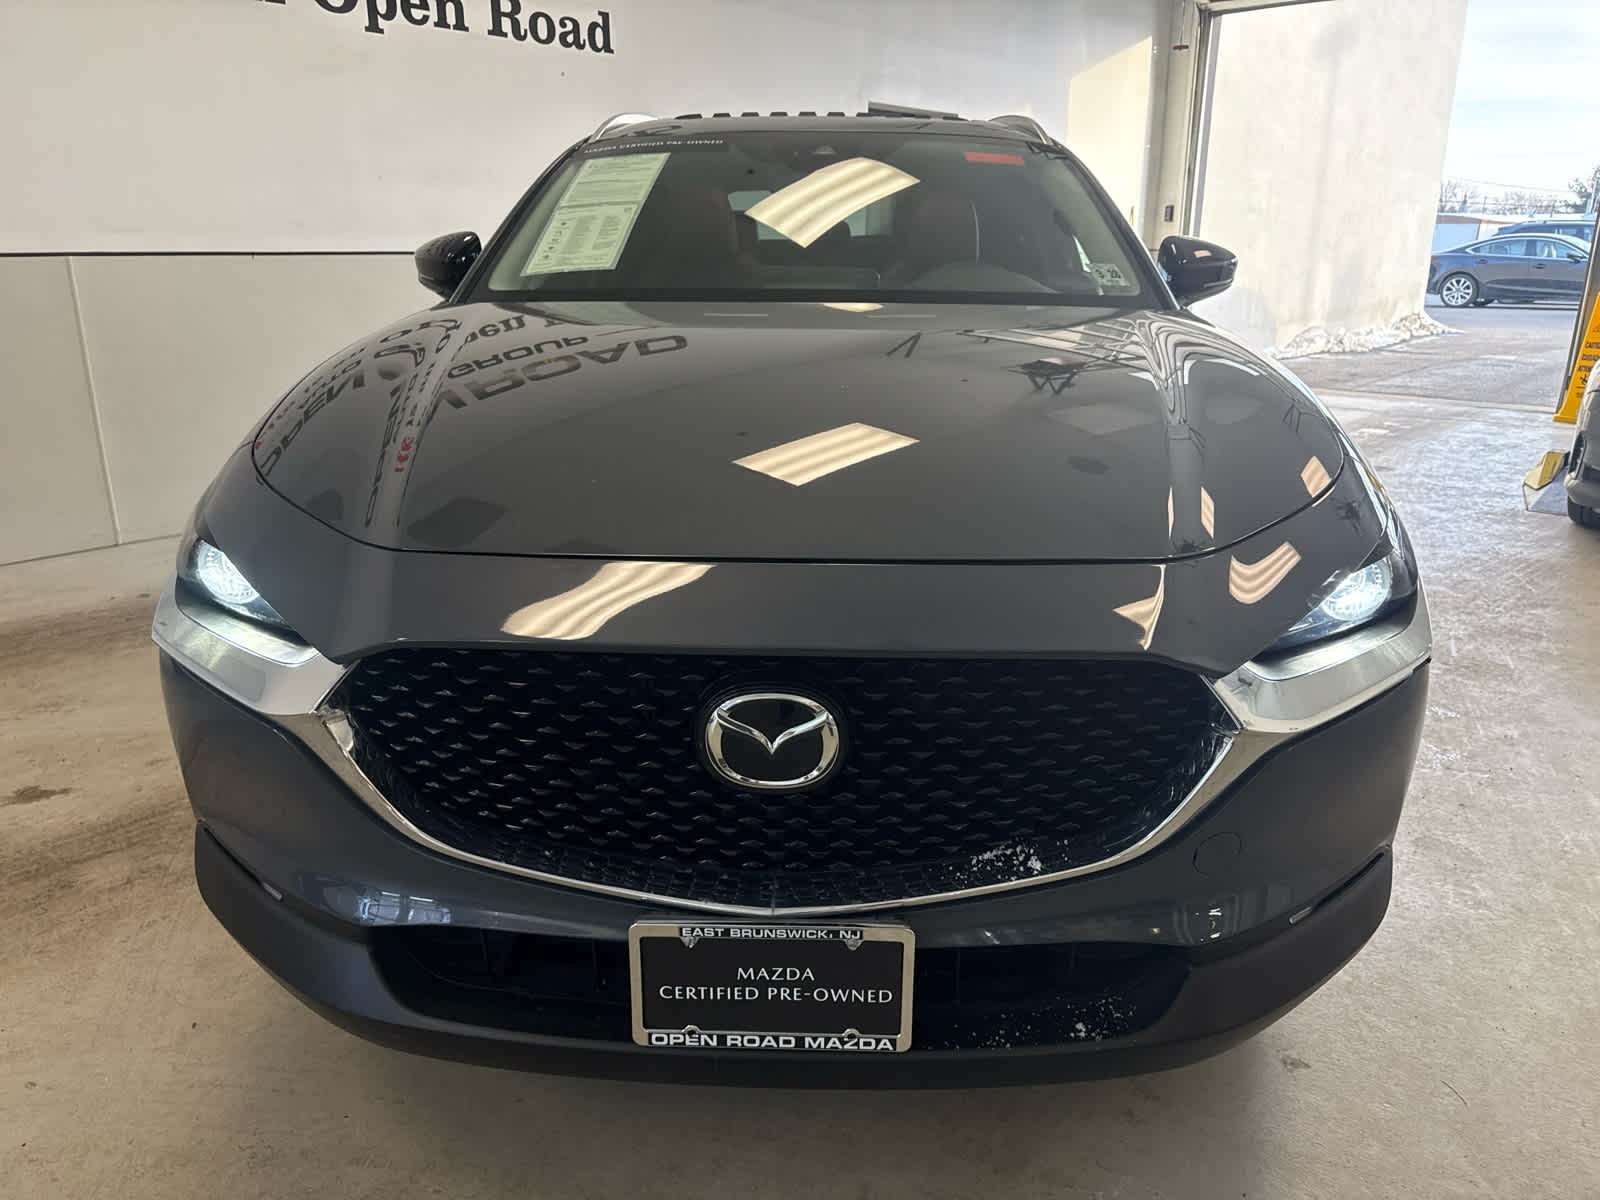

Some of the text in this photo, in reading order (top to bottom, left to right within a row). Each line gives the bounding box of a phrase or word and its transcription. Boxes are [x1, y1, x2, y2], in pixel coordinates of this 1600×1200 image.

[488, 0, 615, 54] Road
[681, 928, 725, 938] EAST
[839, 930, 861, 940] NJ
[736, 967, 816, 982] MAZDA
[658, 985, 893, 1003] CERTIFIED PRE-OWNED
[651, 1033, 894, 1051] OPEN ROAD MAZDA
